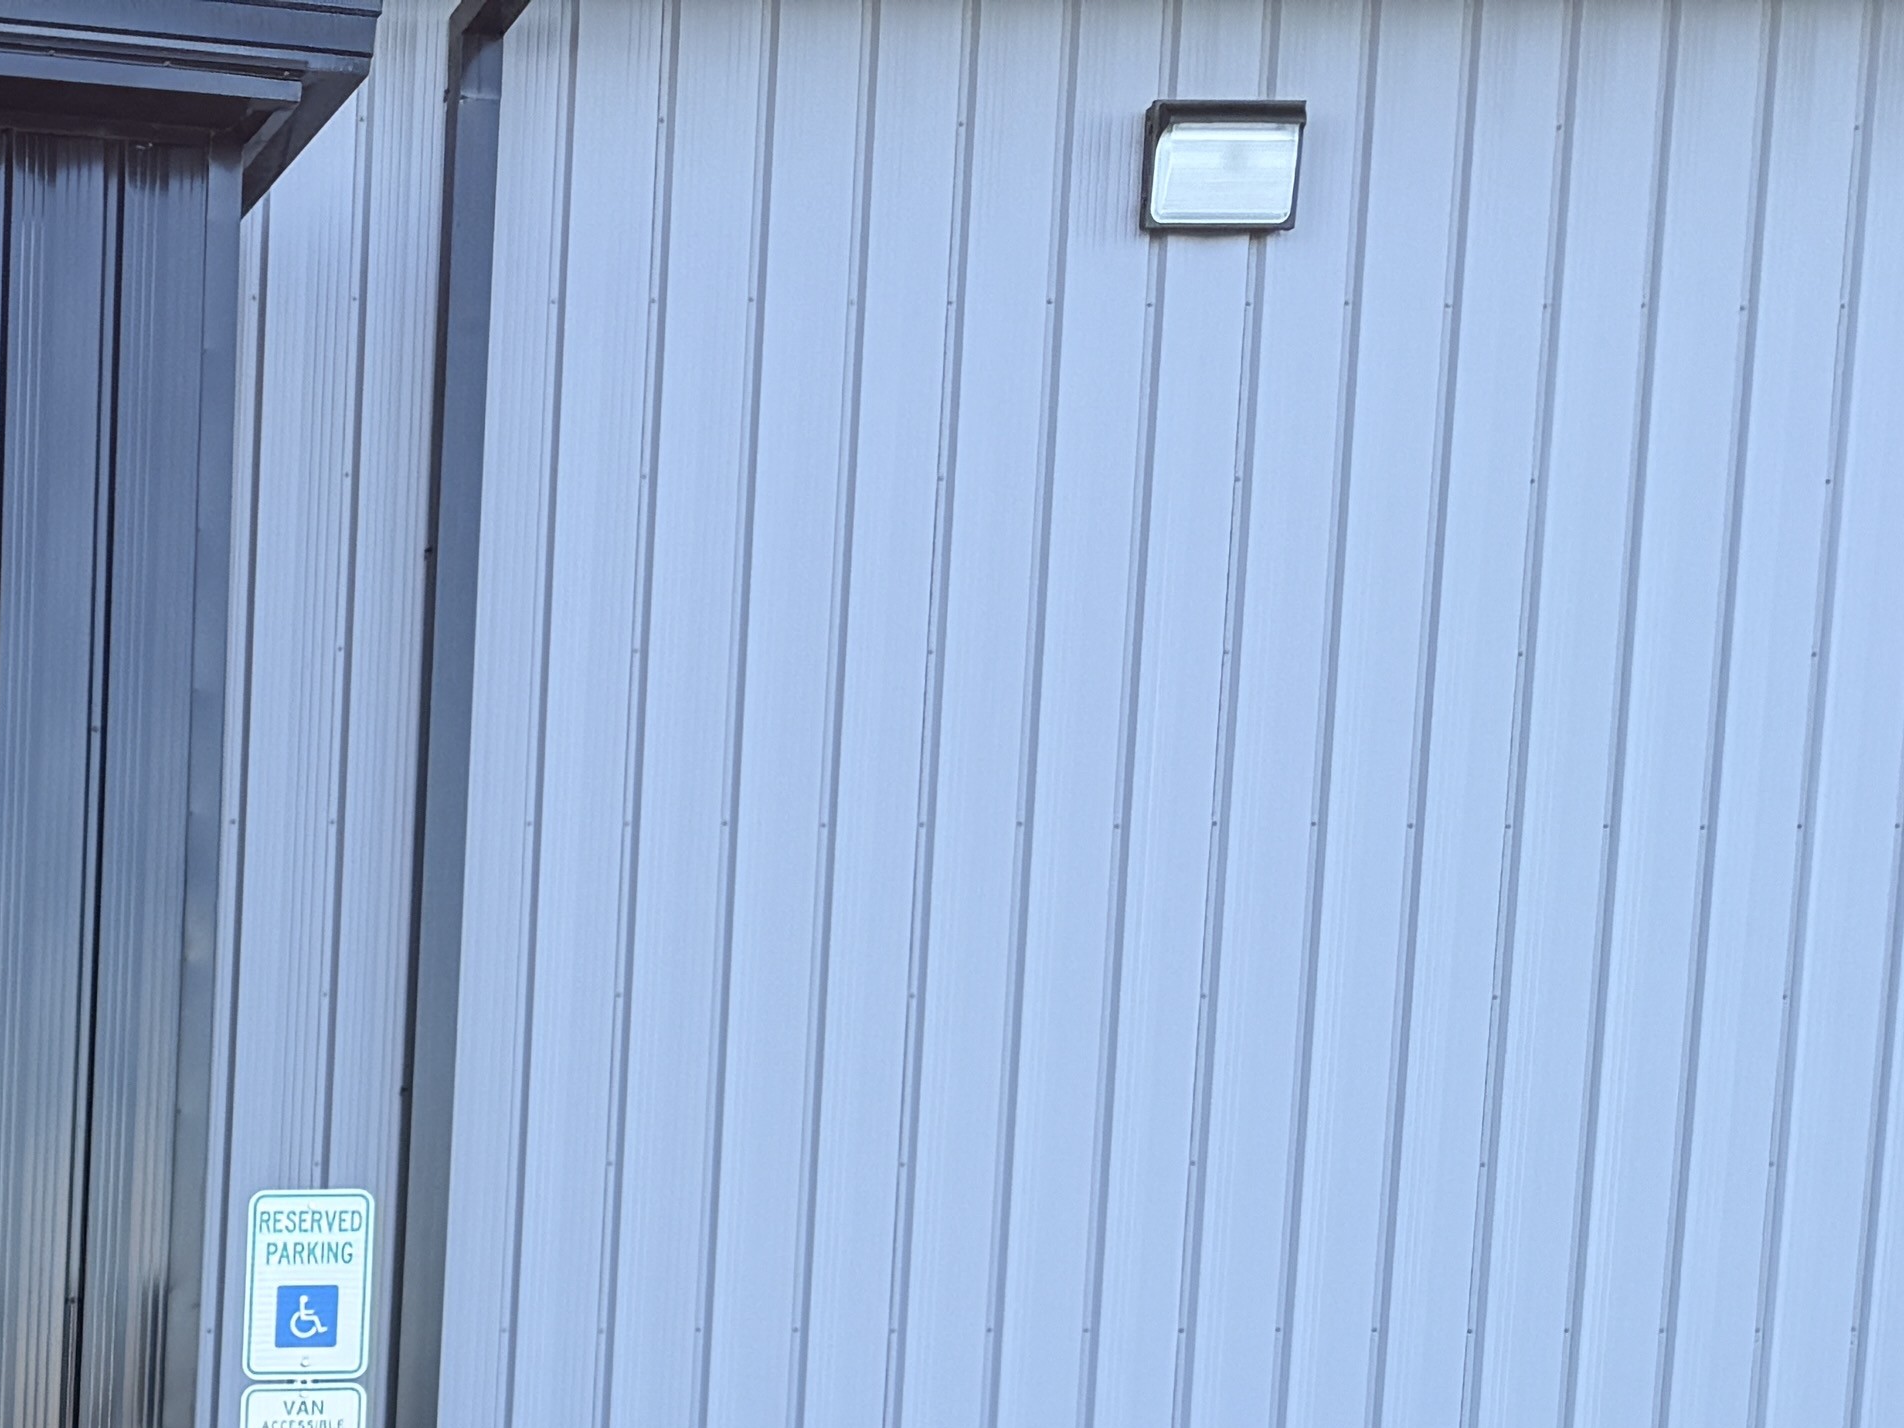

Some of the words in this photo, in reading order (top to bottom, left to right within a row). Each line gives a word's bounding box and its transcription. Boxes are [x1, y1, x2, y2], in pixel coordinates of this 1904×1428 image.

[258, 1209, 363, 1234] RESERVED
[266, 1241, 354, 1265] PARKING
[283, 1400, 324, 1415] VAN
